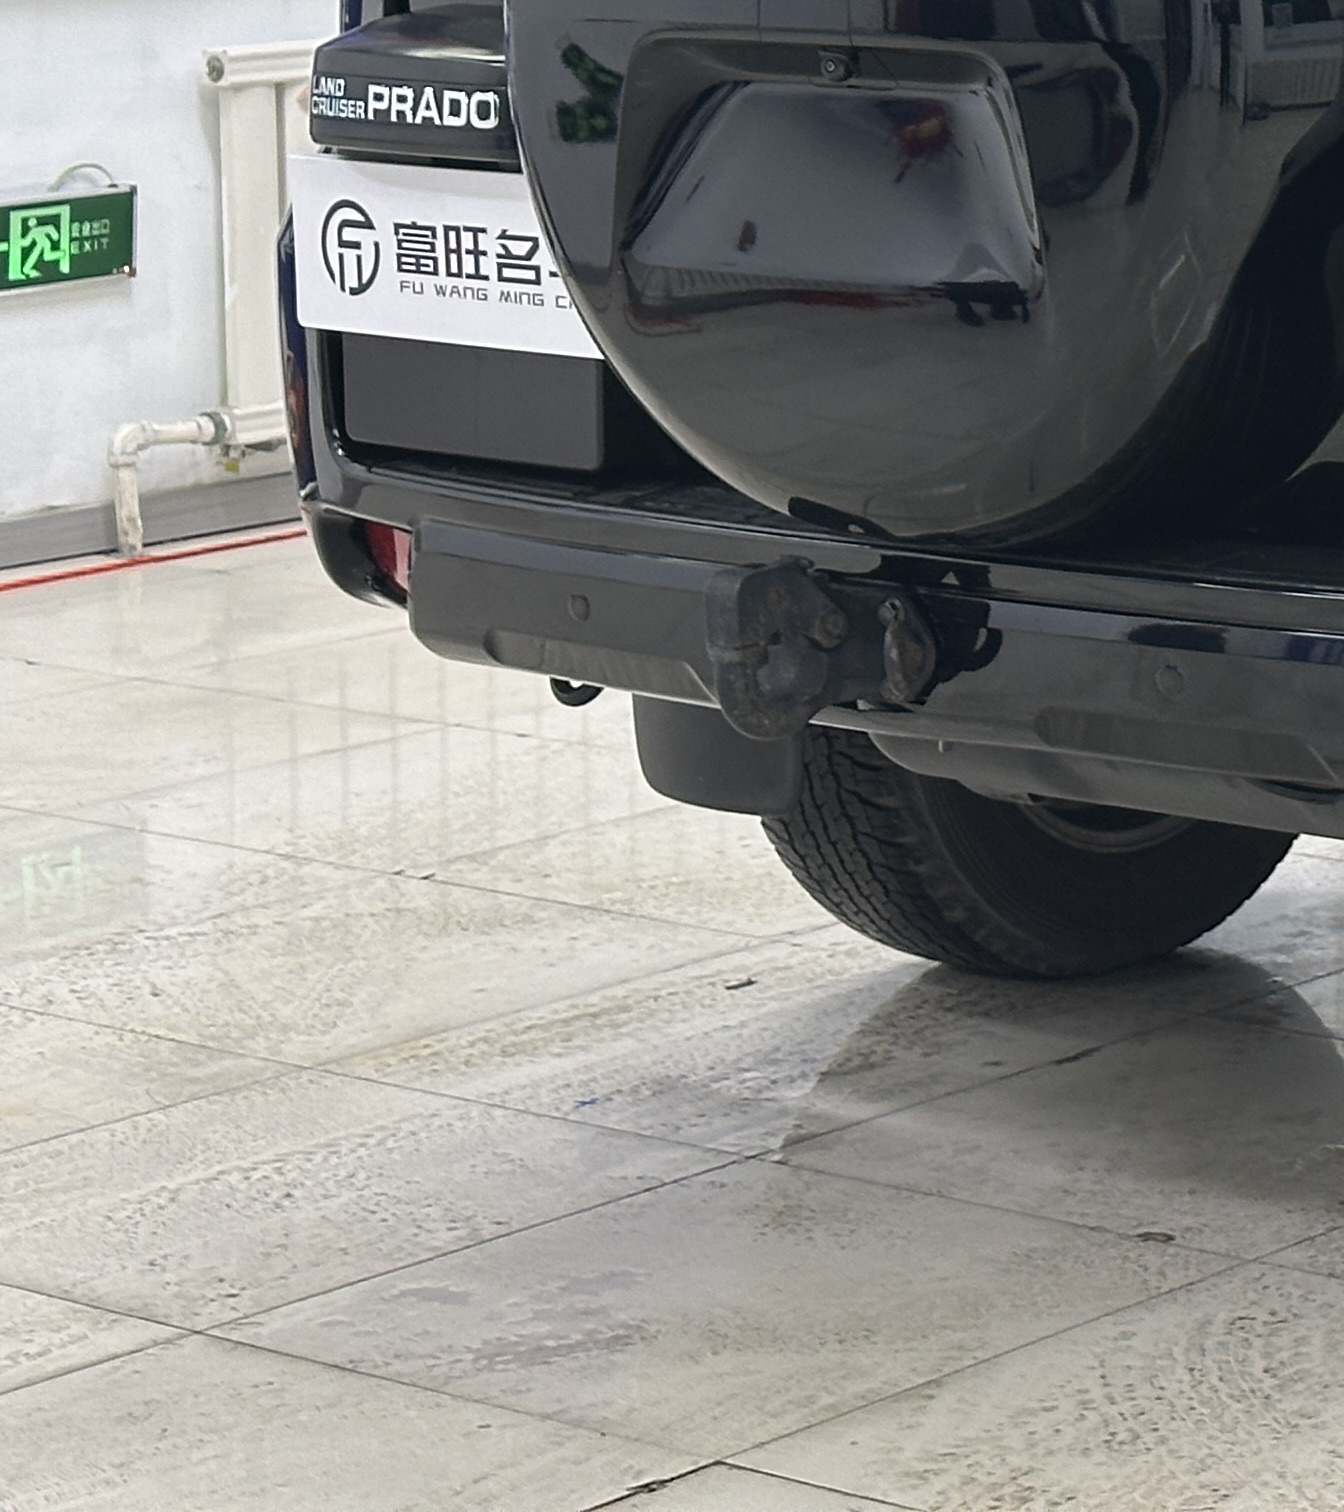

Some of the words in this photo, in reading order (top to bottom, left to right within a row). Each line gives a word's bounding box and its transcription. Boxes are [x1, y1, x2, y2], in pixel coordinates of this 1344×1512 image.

[312, 75, 346, 97] LAND
[311, 96, 366, 119] CRUISER
[367, 84, 500, 129] PRADO
[70, 237, 109, 255] EXIT
[393, 222, 563, 285] 富旺名
[399, 280, 424, 295] FU
[434, 283, 488, 302] WANG
[499, 290, 544, 307] MING
